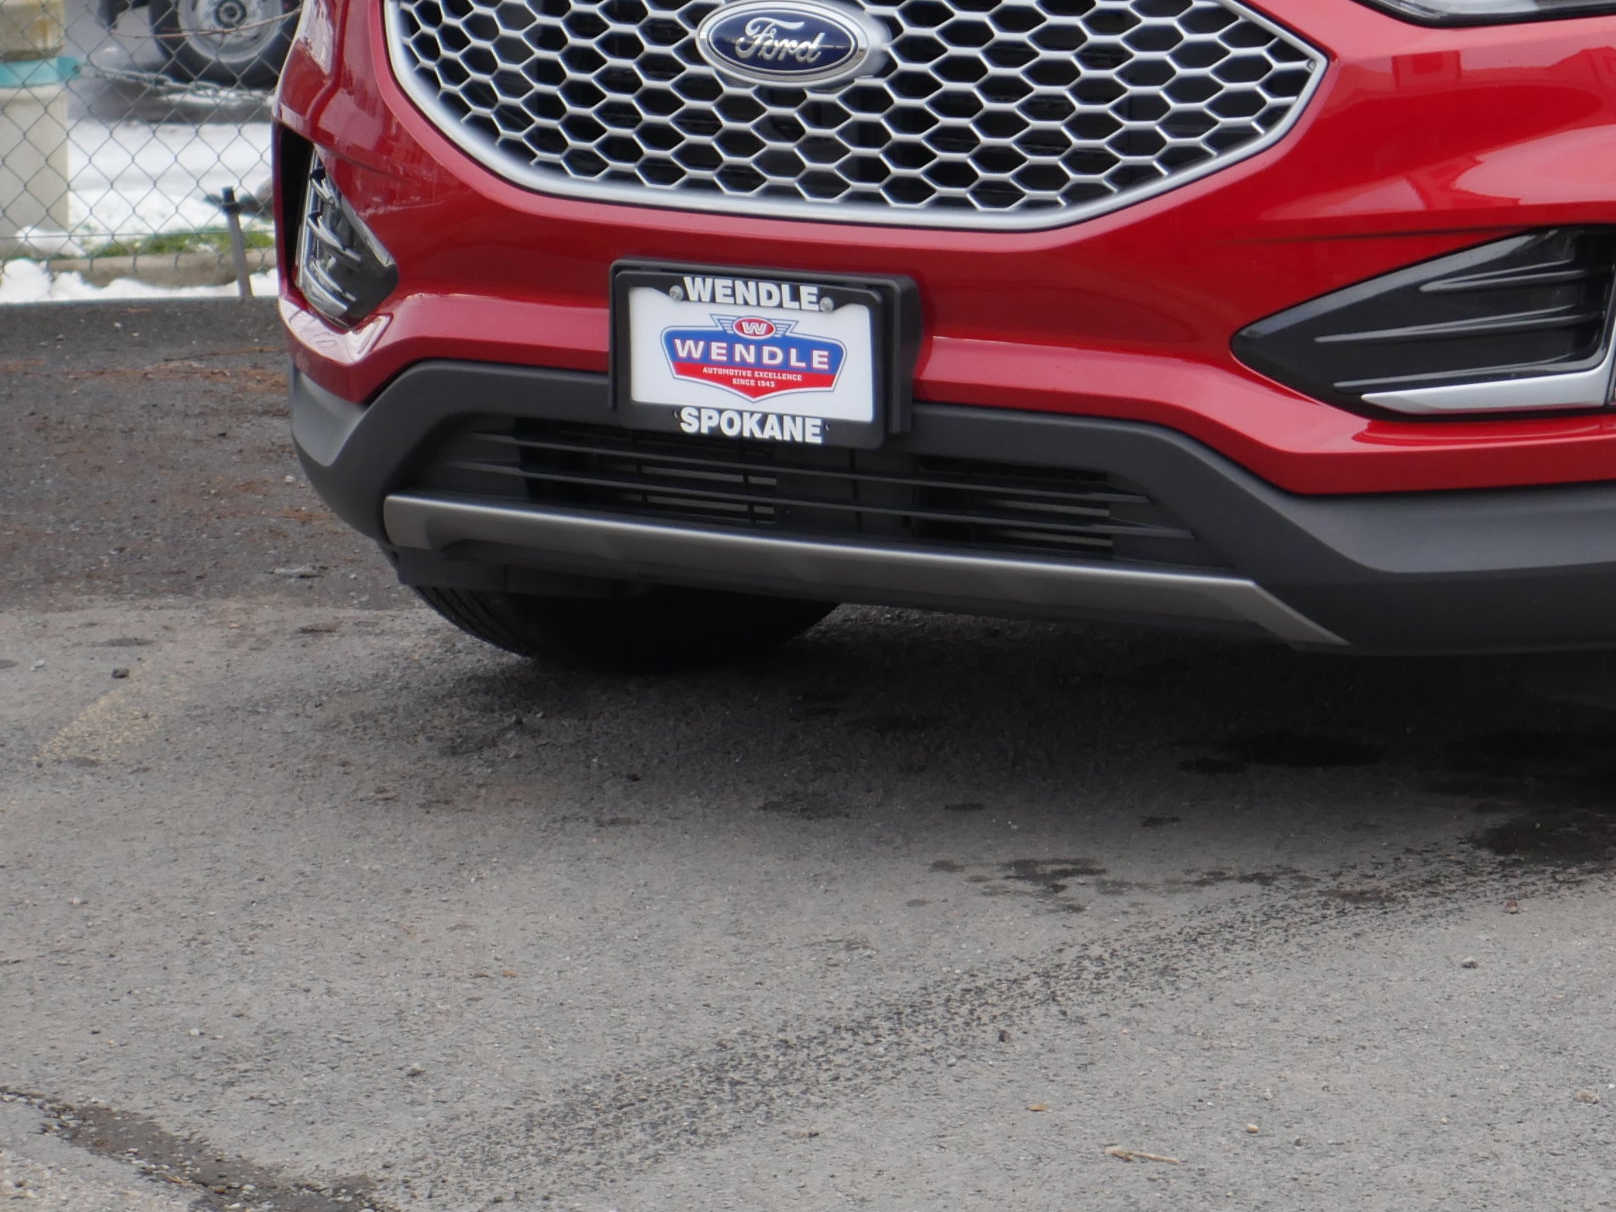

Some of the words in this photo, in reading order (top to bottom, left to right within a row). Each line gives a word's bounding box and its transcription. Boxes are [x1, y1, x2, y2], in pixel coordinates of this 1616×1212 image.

[734, 16, 826, 63] Ford
[683, 276, 821, 311] WENDLE
[674, 338, 830, 370] WENDLE
[702, 366, 752, 378] AUTOMOTIVE
[754, 370, 803, 382] EXCELLENCE
[732, 377, 756, 387] SINCE
[757, 379, 776, 388] 1943
[680, 406, 823, 444] SPOKANE
